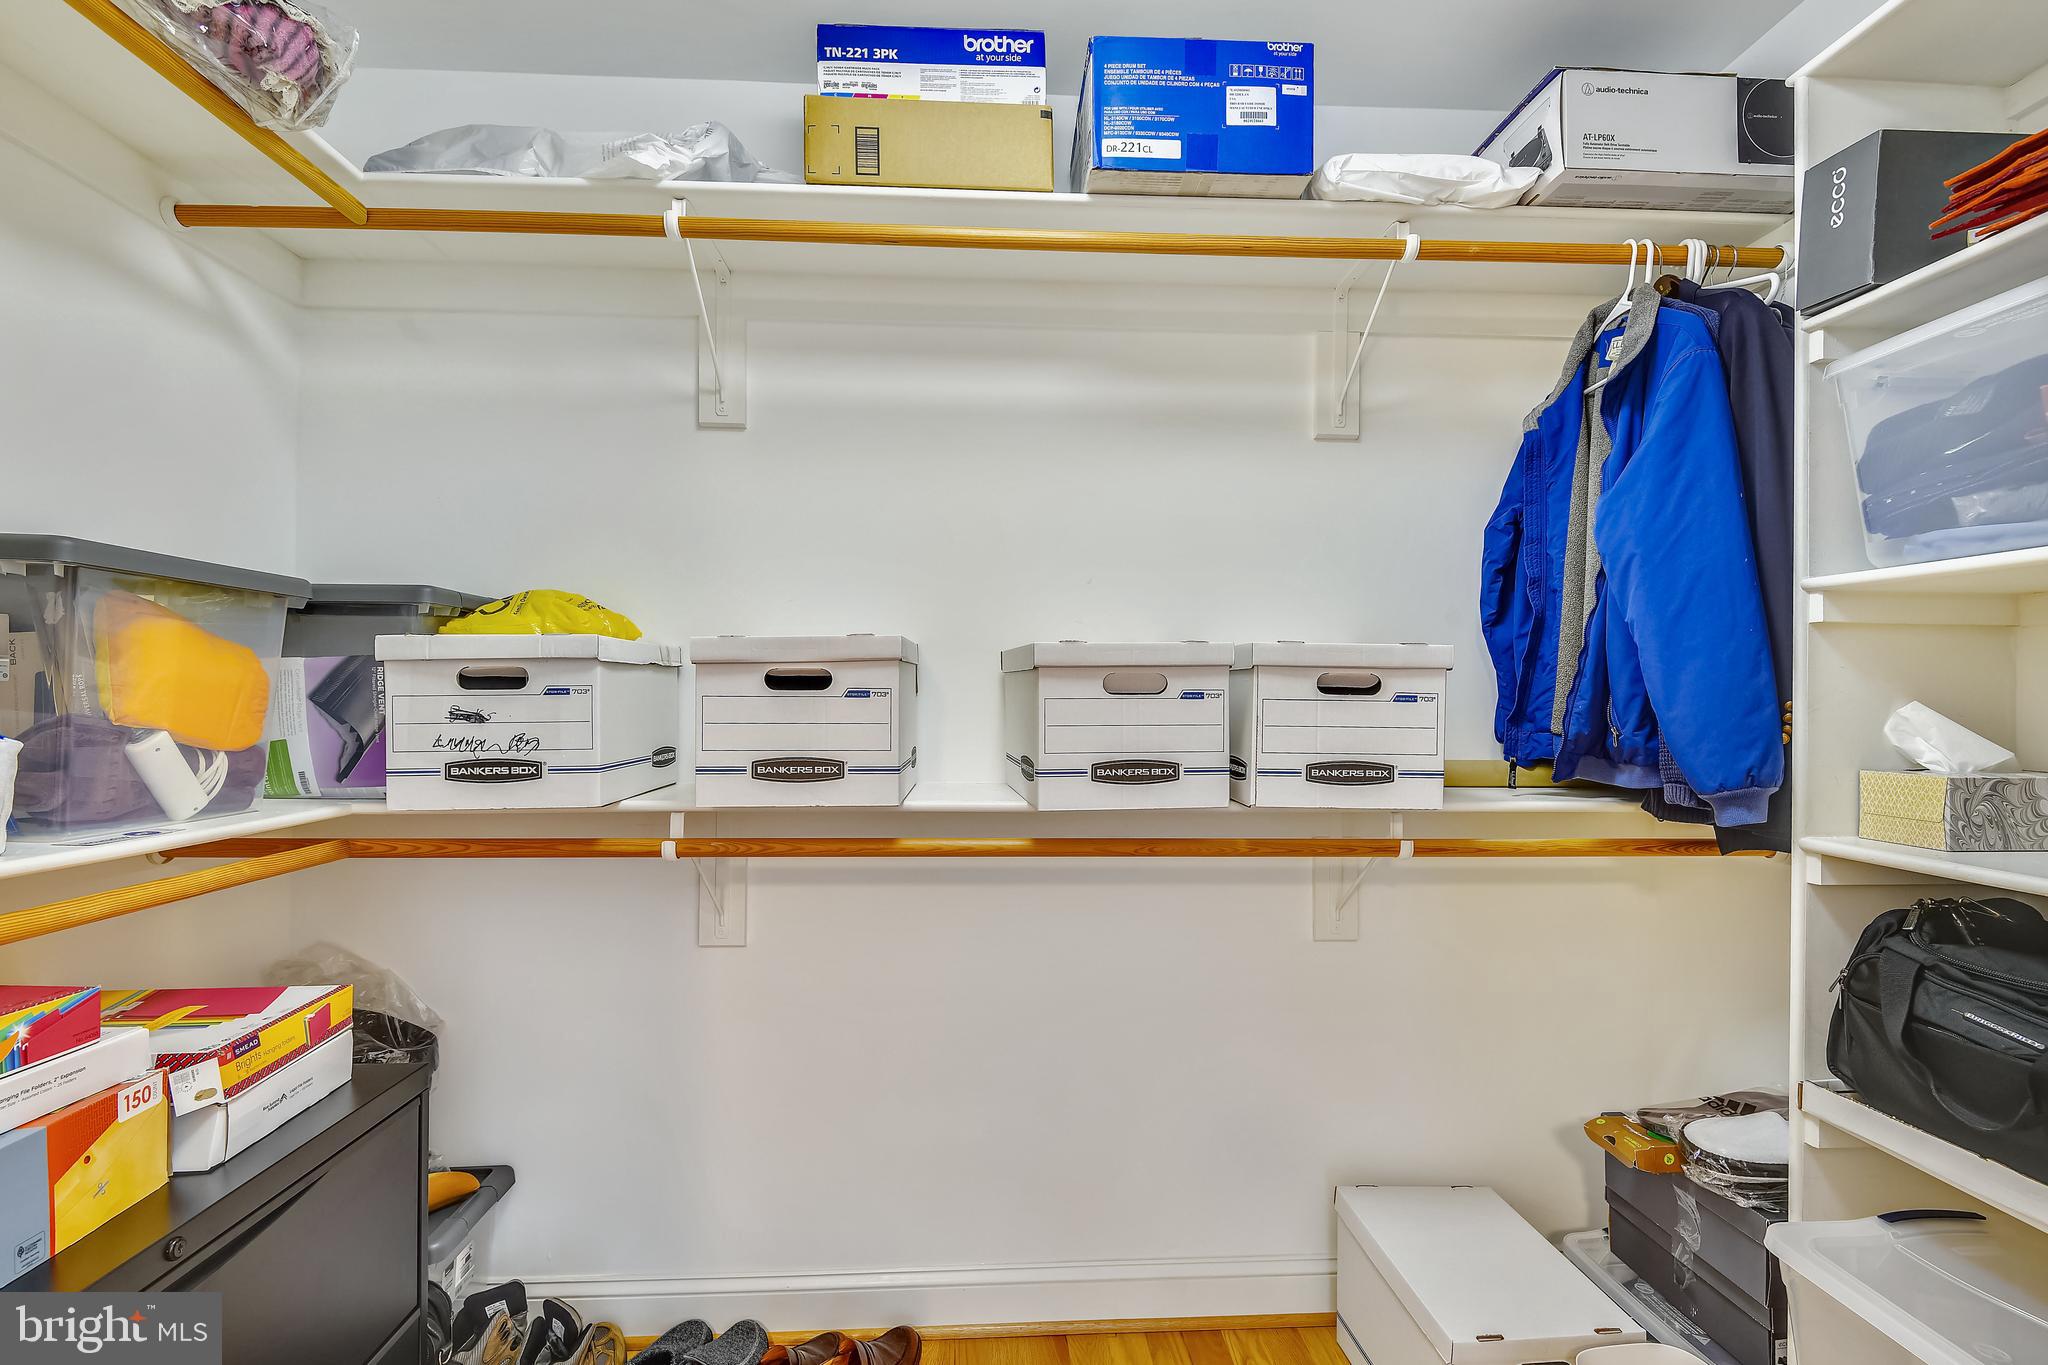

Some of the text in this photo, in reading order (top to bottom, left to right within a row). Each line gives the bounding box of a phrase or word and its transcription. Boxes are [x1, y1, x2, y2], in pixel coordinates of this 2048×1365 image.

[964, 34, 1034, 53] brother
[1267, 42, 1303, 52] brother
[824, 47, 898, 59] TN-221 3PK
[1005, 54, 1022, 62] side
[1596, 86, 1648, 95] audio-technica
[1583, 133, 1615, 141] AT-LP60X
[1106, 142, 1153, 153] DR-221CL
[1830, 166, 1847, 228] ecco
[450, 766, 537, 776] BANKERS BOX
[757, 766, 813, 775] BANKERS
[1097, 768, 1149, 777] BANKERS
[1311, 769, 1364, 778] BANKERS
[235, 1039, 258, 1055] SMEAD
[236, 1052, 262, 1072] Brights
[0, 1092, 19, 1104] anging
[31, 1080, 52, 1092] Folders,
[60, 1066, 86, 1080] Expansion
[124, 1085, 151, 1112] 150
